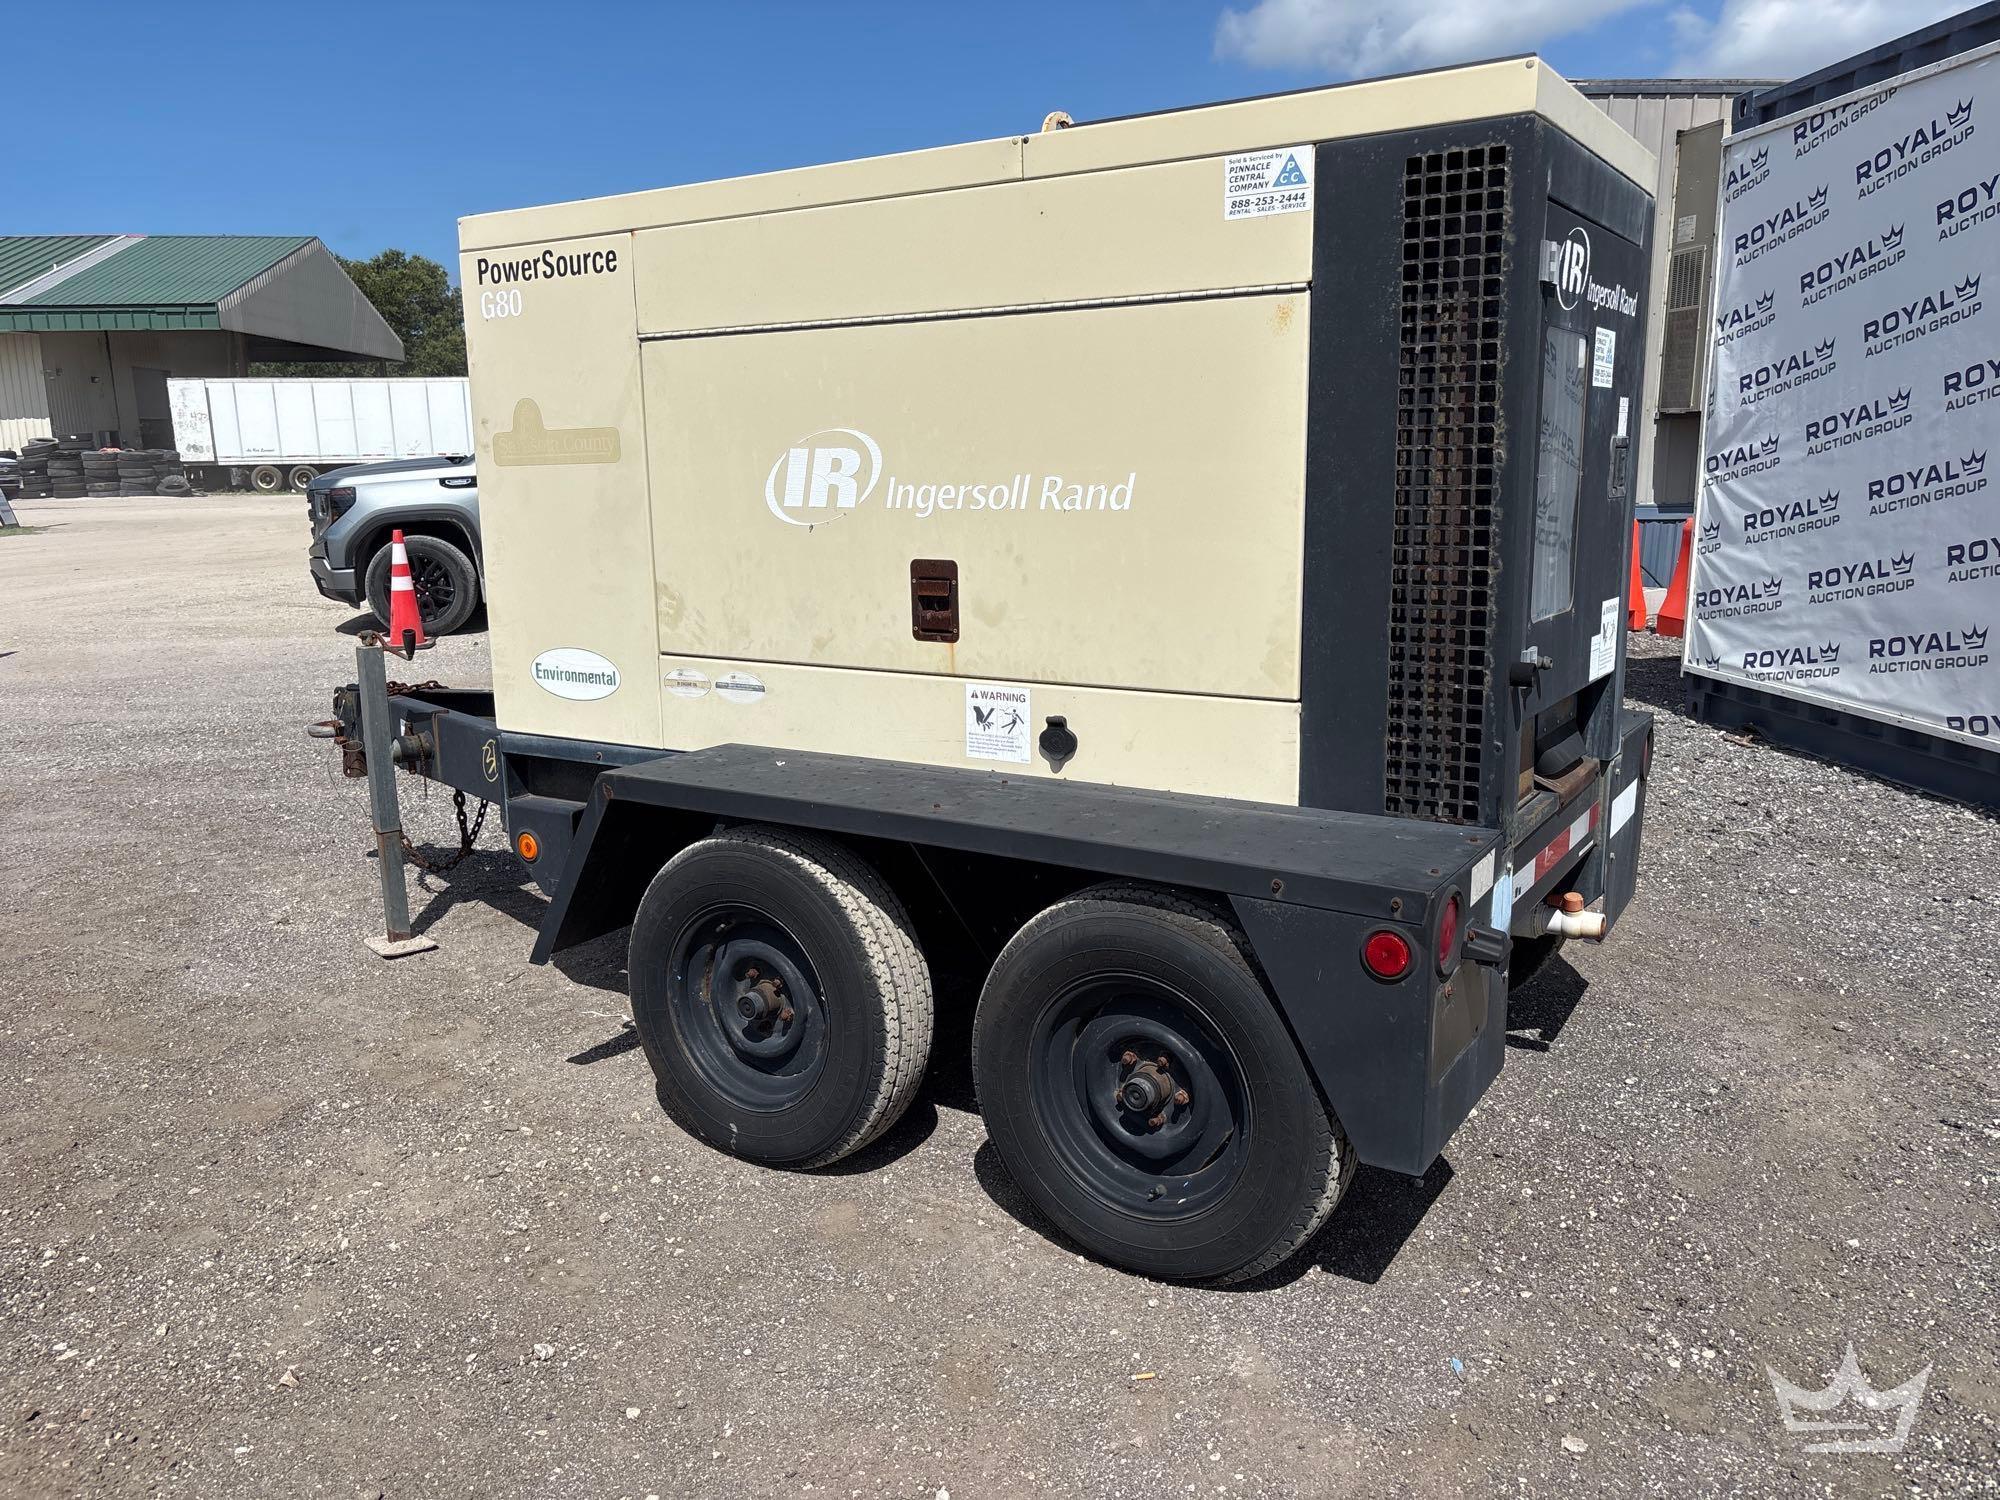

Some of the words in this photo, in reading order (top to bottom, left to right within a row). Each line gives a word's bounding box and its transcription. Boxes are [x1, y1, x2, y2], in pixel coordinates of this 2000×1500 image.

[1795, 117, 1848, 160] AUCTION
[1850, 87, 1898, 123] GROUP
[1229, 161, 1271, 174] PINNACLE
[1249, 153, 1273, 162] Serviced
[1856, 119, 1946, 185] ROYAL
[1857, 157, 1918, 200] AUCTION
[1921, 125, 1975, 165] GROUP
[1229, 172, 1265, 183] CENTRAL
[1229, 181, 1269, 192] COMPANY
[1732, 169, 1770, 200] GROUP
[1229, 208, 1251, 216] RENTAL
[1281, 201, 1306, 209] SERVICE
[1230, 192, 1305, 209] 888-253-2444
[1734, 201, 1809, 254] ROYAL
[1735, 235, 1786, 268] AUCTION
[1788, 208, 1830, 240] GROUP
[477, 249, 618, 285] PowerSource
[1562, 239, 1585, 294] IR
[1800, 240, 1881, 293] ROYAL
[1801, 275, 1856, 309] AUCTION
[1858, 249, 1906, 281] GROUP
[480, 289, 523, 319] G80
[1587, 275, 1620, 311] Ingersoll
[1619, 288, 1638, 317] Rand
[1736, 313, 1776, 339] GROUP
[1863, 289, 1954, 343] ROYAL
[1865, 324, 1926, 359] AUCTION
[1929, 301, 1982, 332] GROUP
[1739, 348, 1815, 393] ROYAL
[1740, 381, 1792, 407] AUCTION
[1794, 361, 1836, 391] GROUP
[1805, 400, 1887, 442] ROYAL
[1807, 429, 1862, 457] AUCTION
[1864, 413, 1913, 440] GROUP
[784, 447, 861, 508] IR
[1741, 456, 1780, 477] GROUP
[1867, 460, 1960, 500] ROYAL
[886, 474, 1031, 518] Ingersoll
[1040, 472, 1136, 511] Rand
[1869, 490, 1930, 516] AUCTION
[1934, 478, 1988, 501] GROUP
[1743, 498, 1819, 531] ROYAL
[1744, 524, 1796, 546] AUCTION
[1797, 513, 1841, 536] GROUP
[1697, 543, 1721, 555] OUP
[1808, 558, 1890, 591] ROYAL
[1696, 582, 1762, 608] ROYAL
[1808, 585, 1864, 605] AUCTION
[1866, 579, 1915, 597] GROUP
[1697, 606, 1741, 621] AUCTION
[1743, 600, 1782, 615] GROUP
[1742, 646, 1818, 669] ROYAL
[1869, 631, 1961, 658] ROYAL
[535, 662, 617, 687] Environmental
[1796, 667, 1840, 680] GROUP
[1869, 659, 1931, 674] AUCTION
[1934, 654, 1989, 670] GROUP
[980, 690, 1026, 703] WARNING
